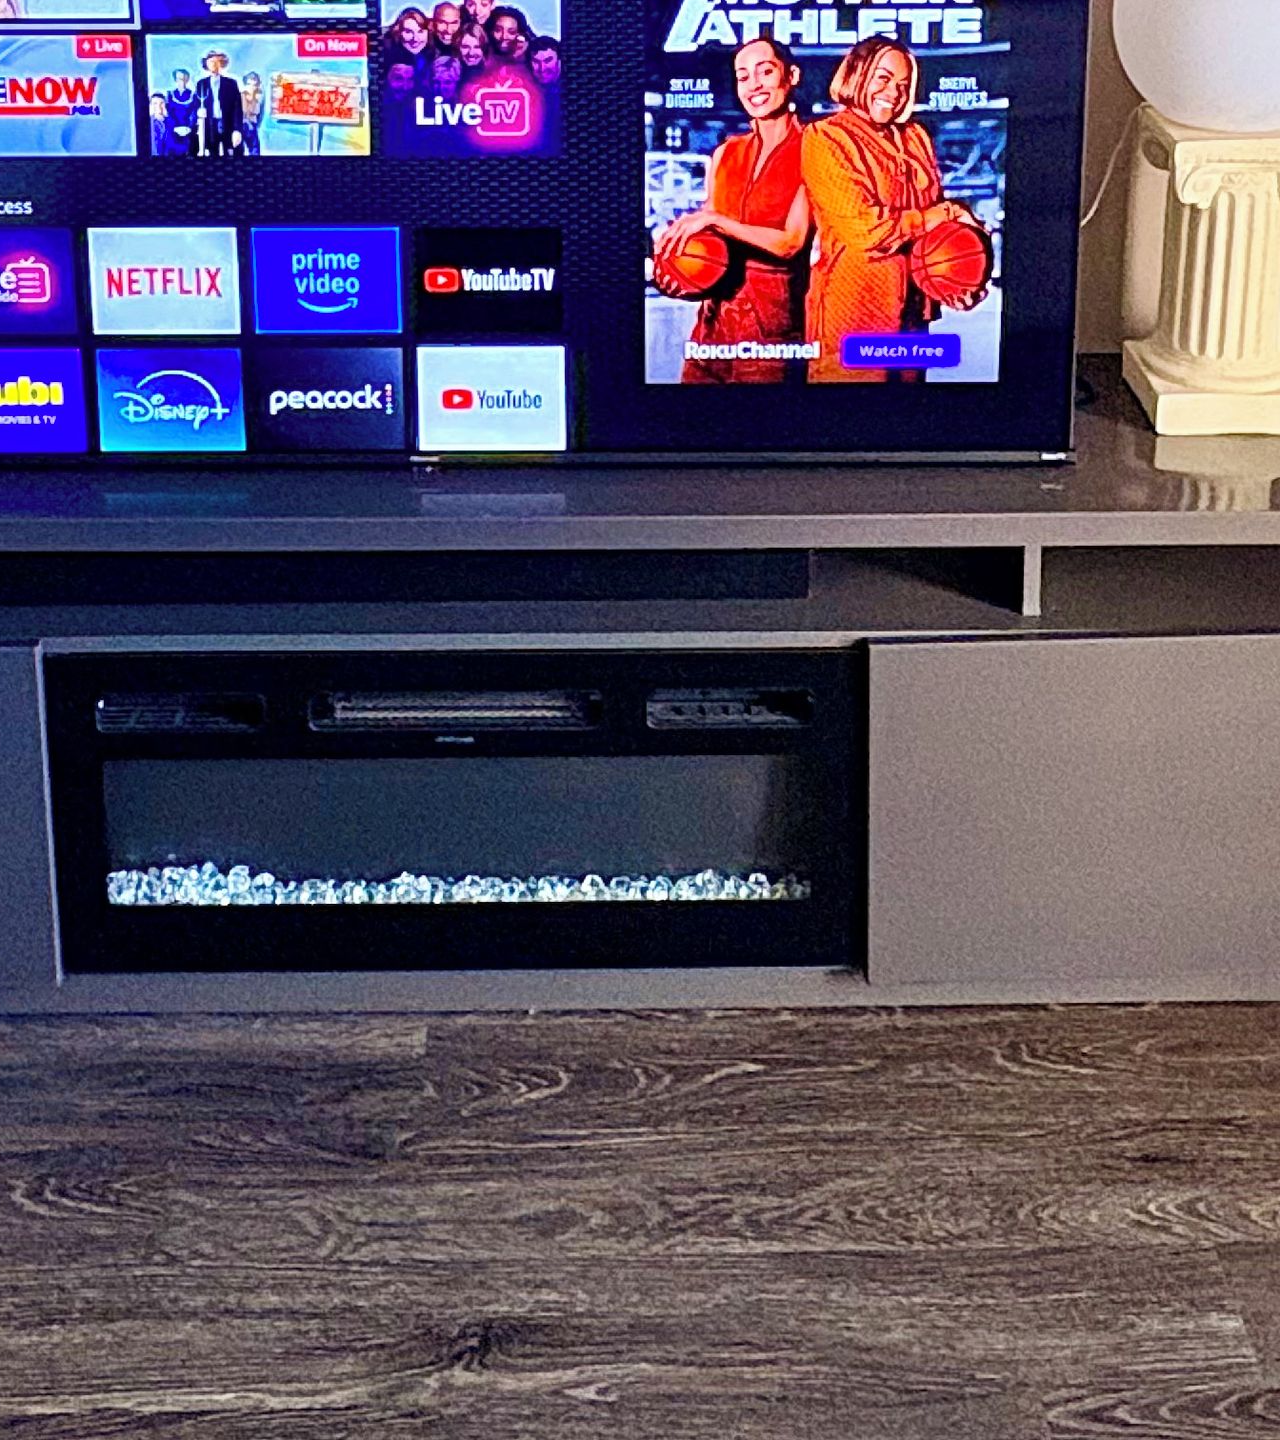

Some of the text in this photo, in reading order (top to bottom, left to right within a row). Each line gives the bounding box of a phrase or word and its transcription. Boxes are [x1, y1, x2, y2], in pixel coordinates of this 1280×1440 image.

[696, 7, 983, 46] ATHLETE
[94, 39, 123, 53] Live
[304, 38, 359, 53] On Now
[415, 95, 520, 126] Live TV
[292, 248, 361, 274] prime
[106, 266, 222, 298] NETFLIX
[294, 272, 360, 294] video
[859, 343, 945, 358] Watch free
[269, 383, 384, 415] peacock
[477, 389, 543, 409] YouTube
[42, 415, 57, 425] TV
